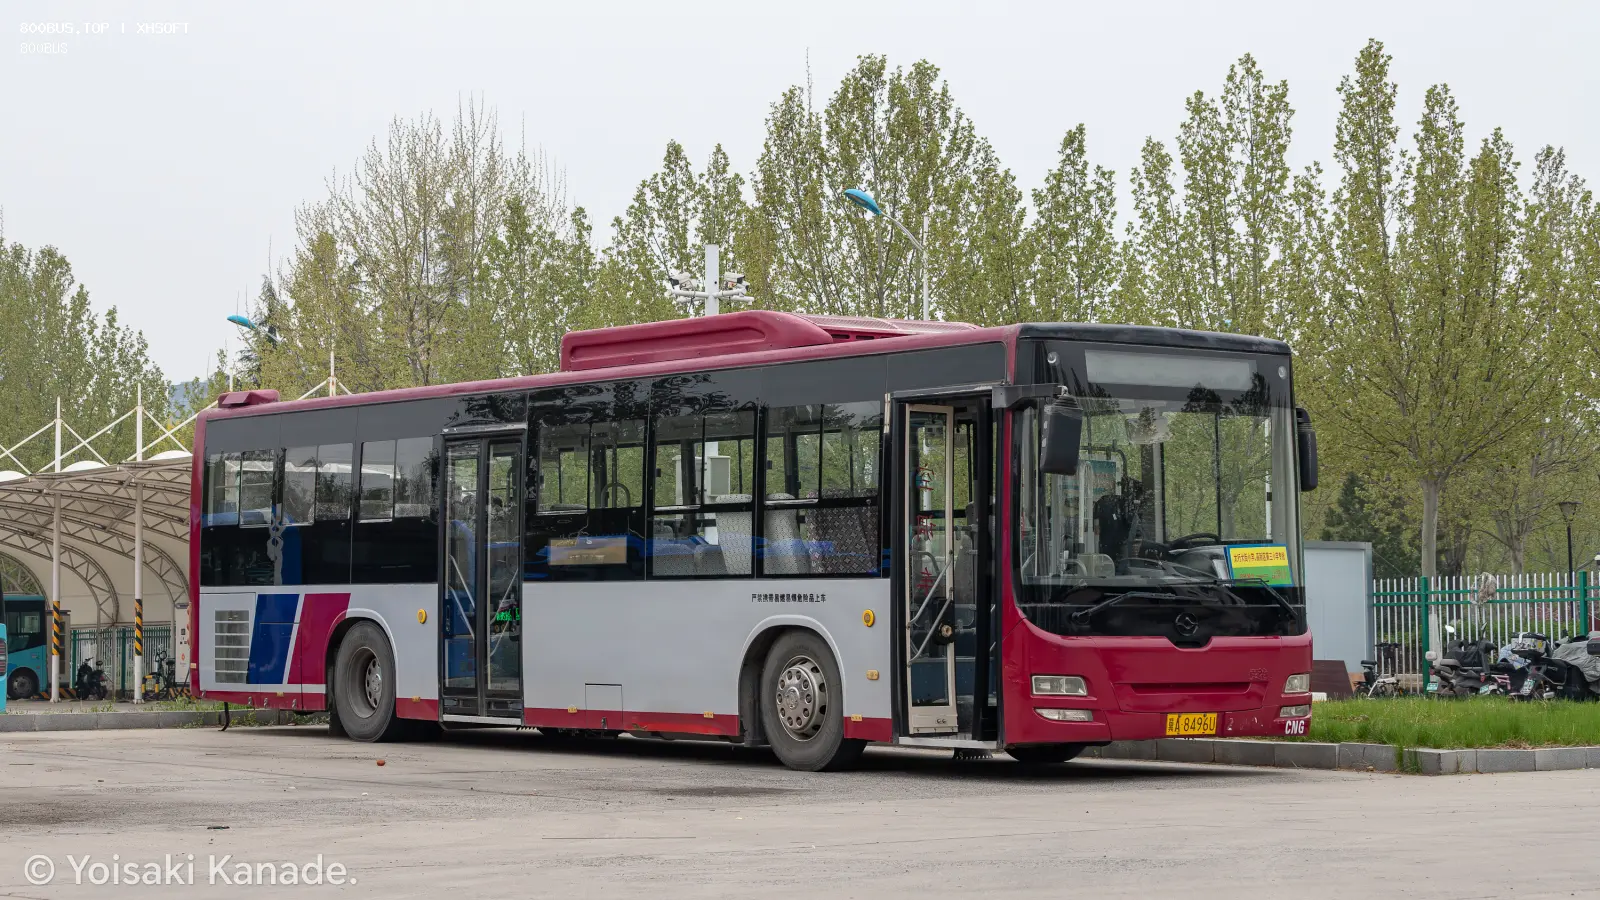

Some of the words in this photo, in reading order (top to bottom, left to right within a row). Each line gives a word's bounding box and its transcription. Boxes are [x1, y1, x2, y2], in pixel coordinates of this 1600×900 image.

[751, 593, 827, 603] 严禁携带易燃易爆危险品上车
[1285, 720, 1305, 734] CNG
